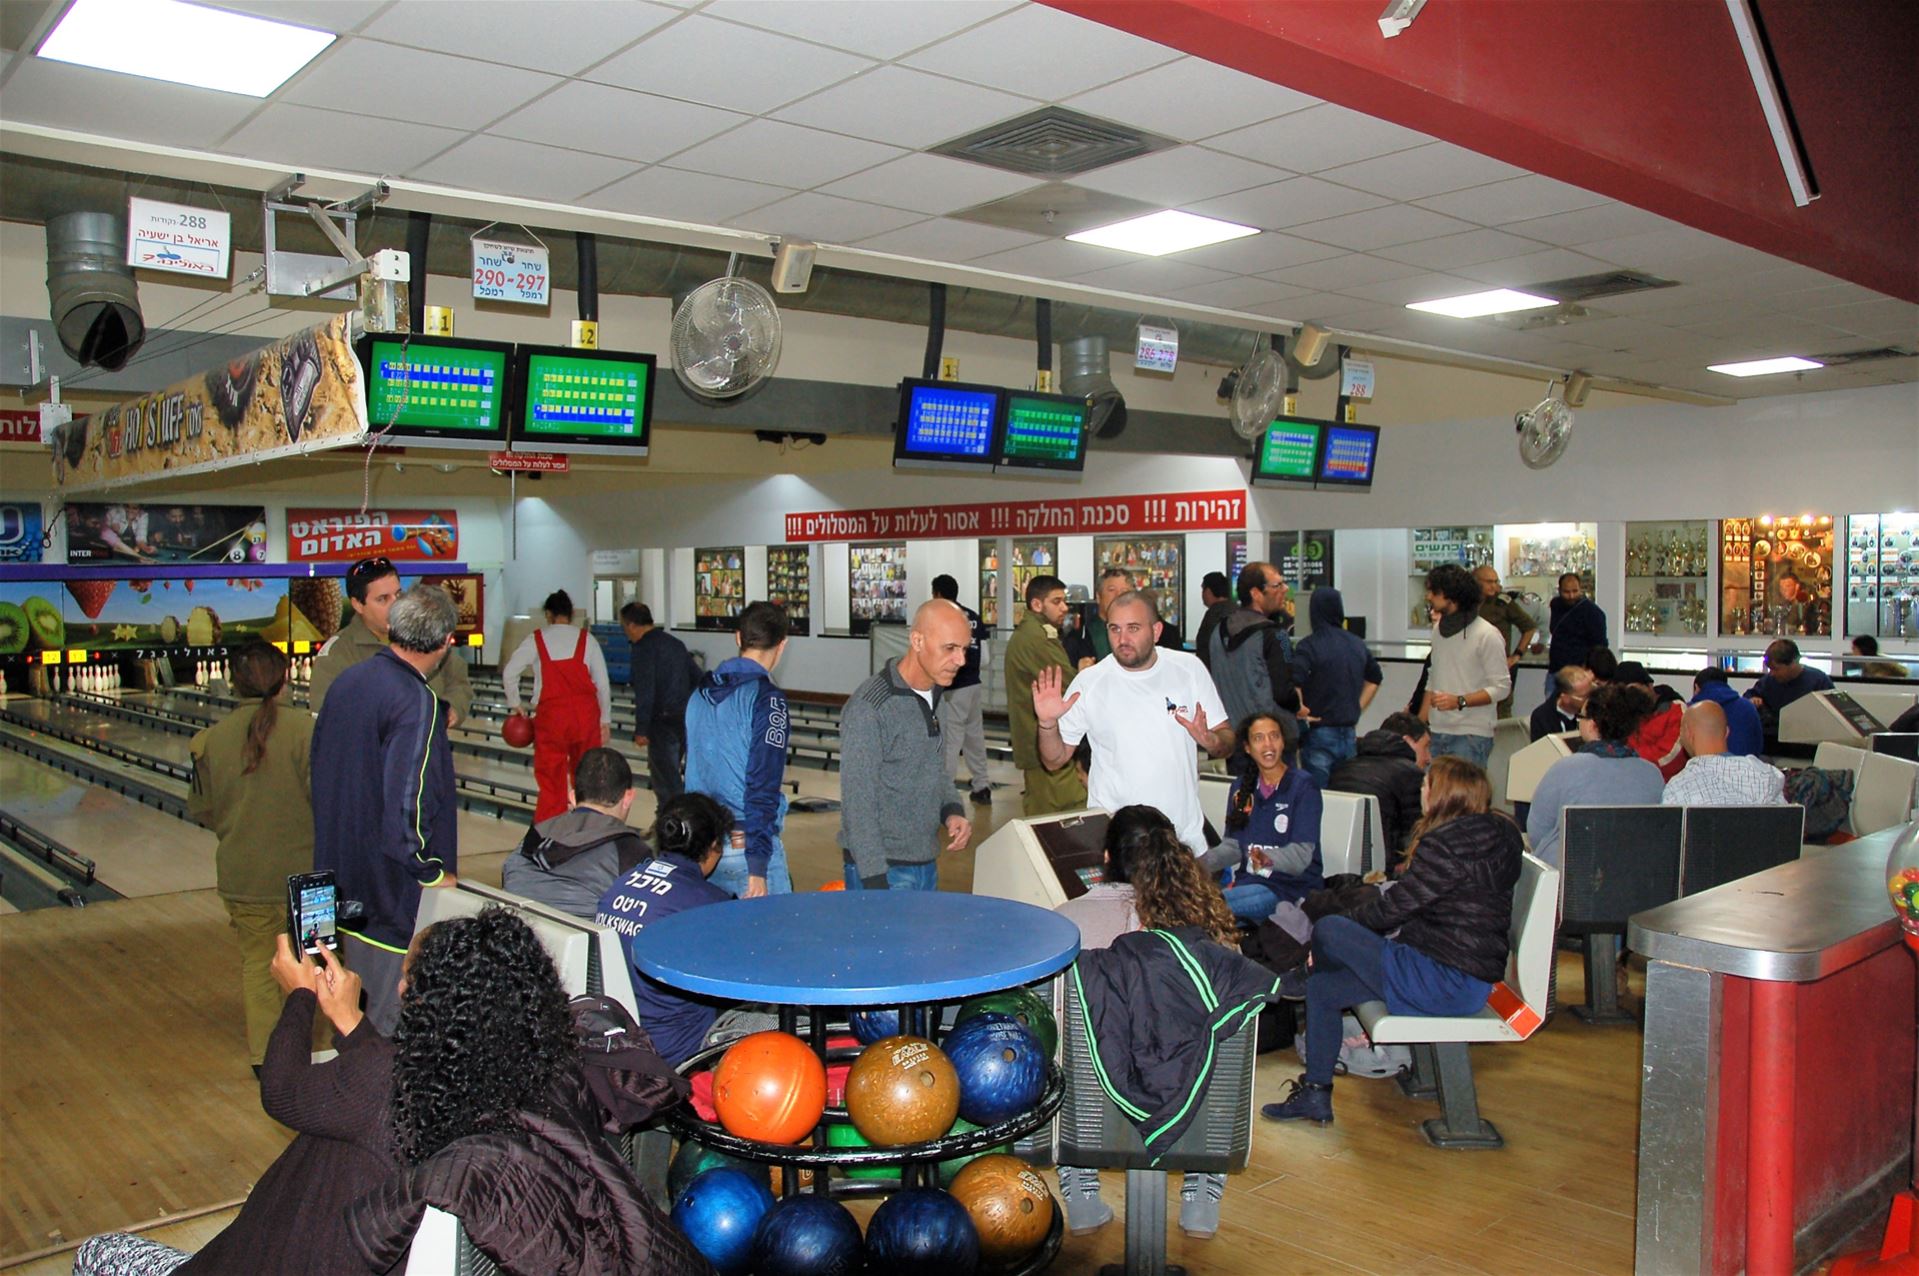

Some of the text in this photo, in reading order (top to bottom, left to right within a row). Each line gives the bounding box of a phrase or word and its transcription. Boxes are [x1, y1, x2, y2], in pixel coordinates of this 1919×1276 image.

[180, 214, 207, 229] 288
[138, 229, 219, 248] אריאל בן ישעיה
[479, 256, 502, 267] שחר
[521, 261, 542, 271] שחר
[479, 286, 504, 297] רמפל
[520, 289, 543, 300] רמפל
[125, 400, 147, 450] HOT
[147, 394, 184, 447] STUFF
[291, 511, 390, 538] הפיראט
[787, 498, 1241, 536] זהירות !!! סכנת החלקה !!! אסור לעלות על המסלולים !!!
[300, 530, 382, 556] האדום
[70, 550, 92, 558] INTER
[233, 549, 242, 560] 8
[625, 872, 673, 895] מיכל
[612, 895, 648, 917] ריטס
